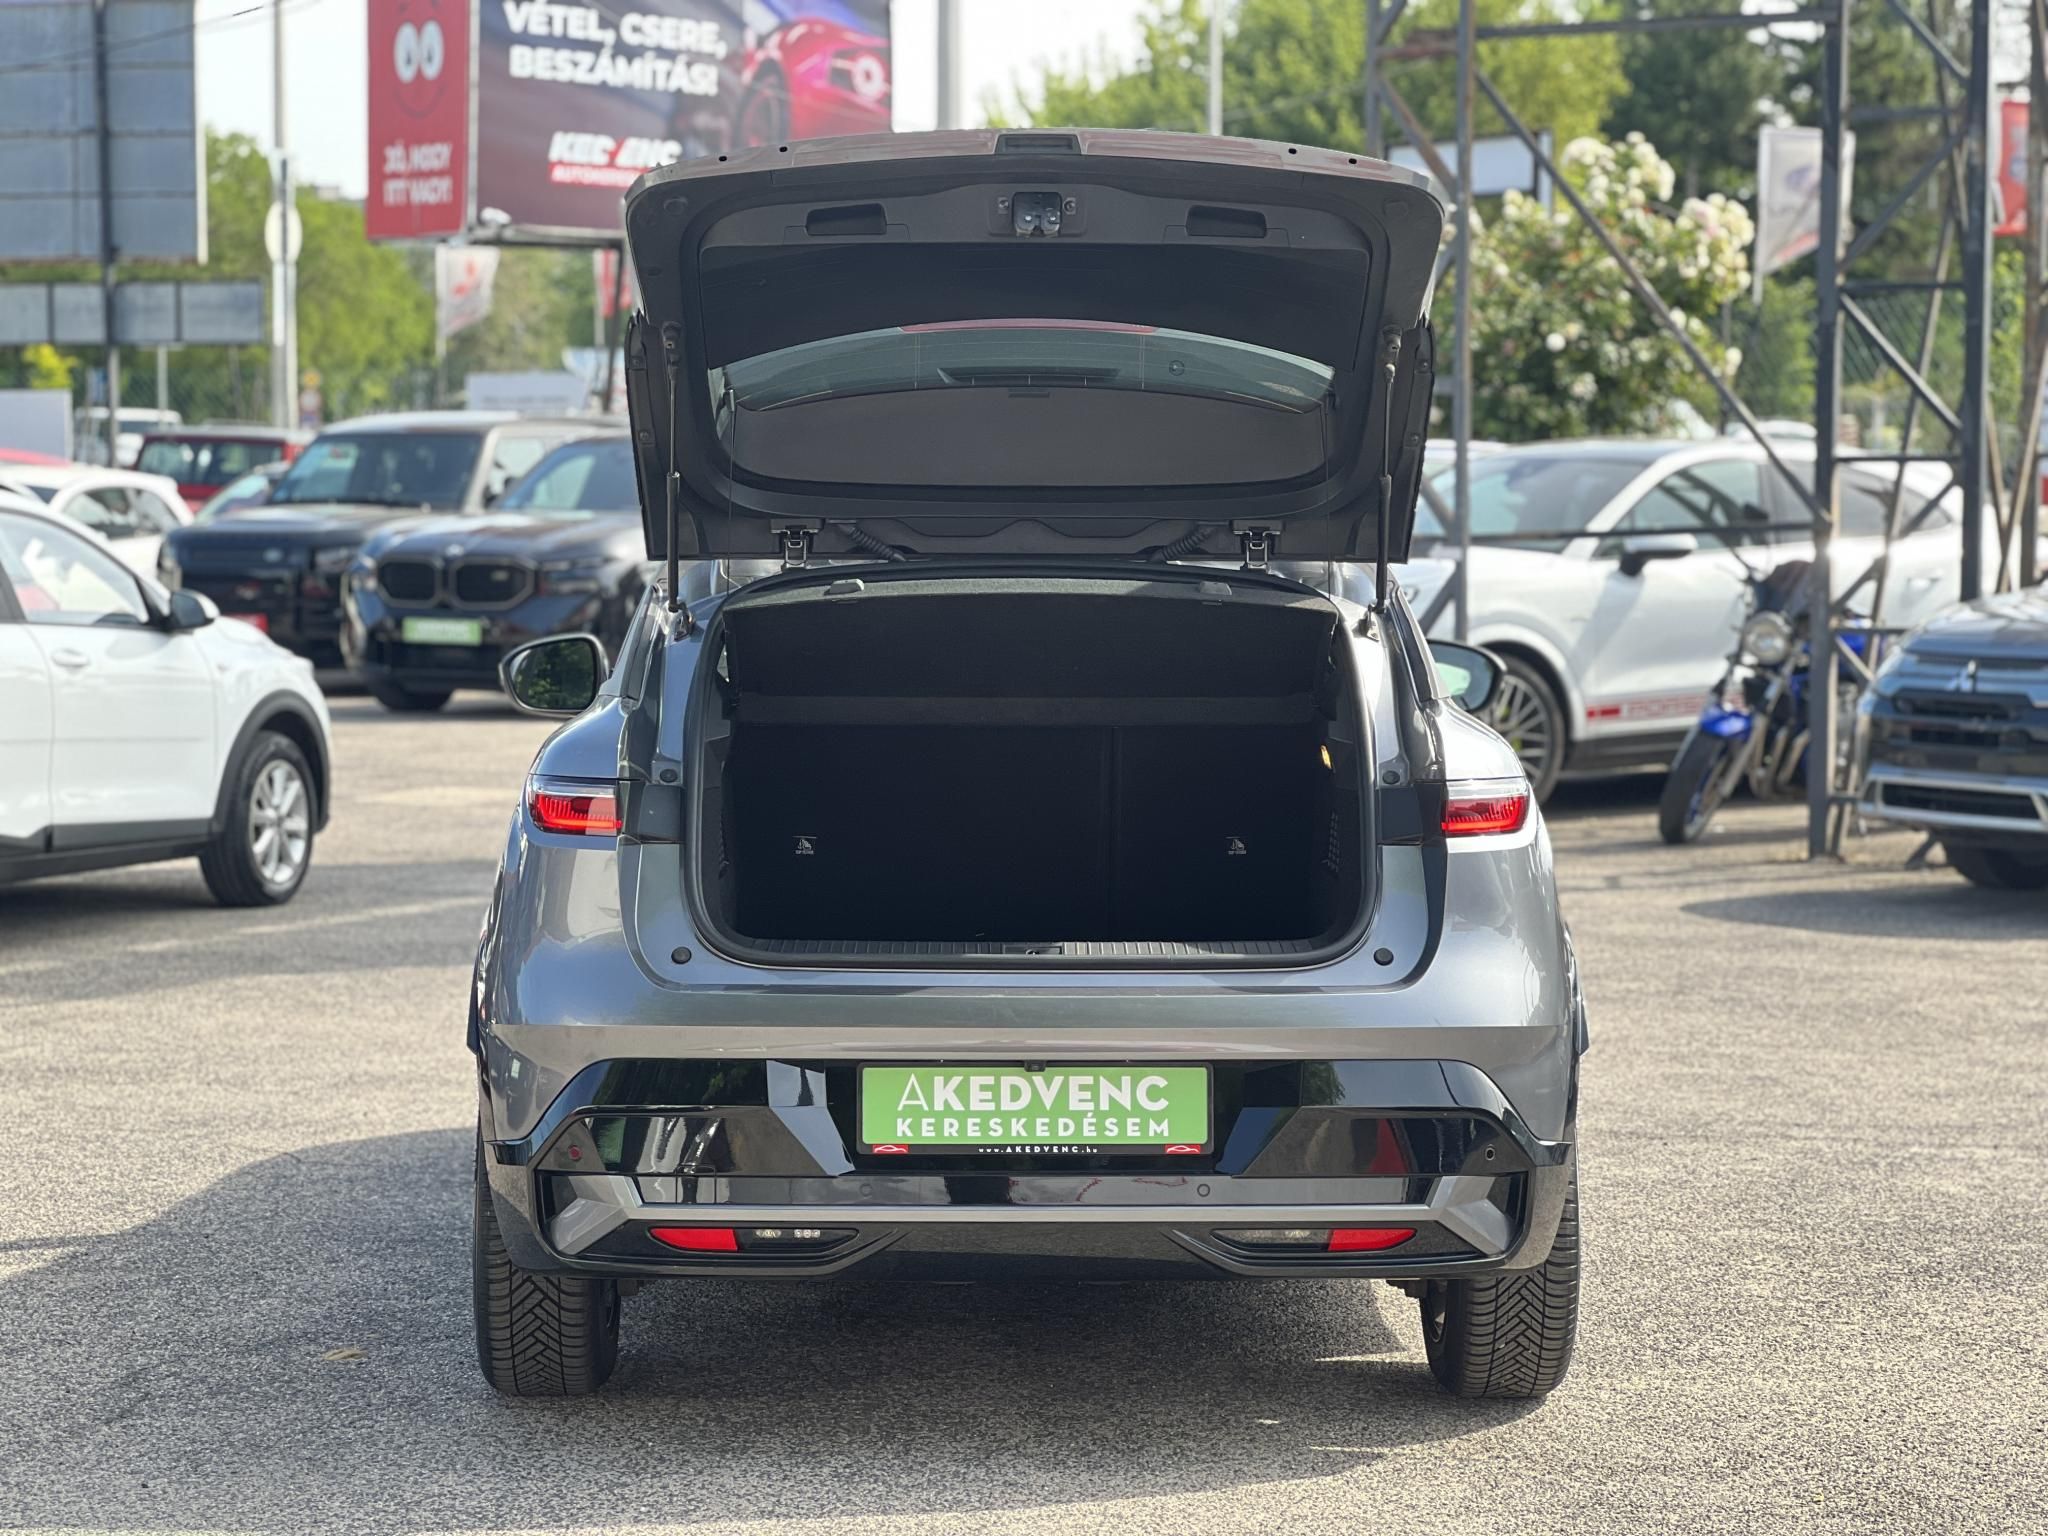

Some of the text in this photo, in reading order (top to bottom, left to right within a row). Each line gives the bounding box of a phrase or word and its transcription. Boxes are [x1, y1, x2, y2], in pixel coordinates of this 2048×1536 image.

[503, 0, 728, 60] VÉTEL, CSERE,
[508, 43, 719, 96] BESZÁMÍTÁS!
[897, 1073, 1169, 1111] AKEDVENC
[897, 1112, 1169, 1137] KERESKEDÉSEM
[978, 1145, 1097, 1153] www.AKEDVENC.hu
